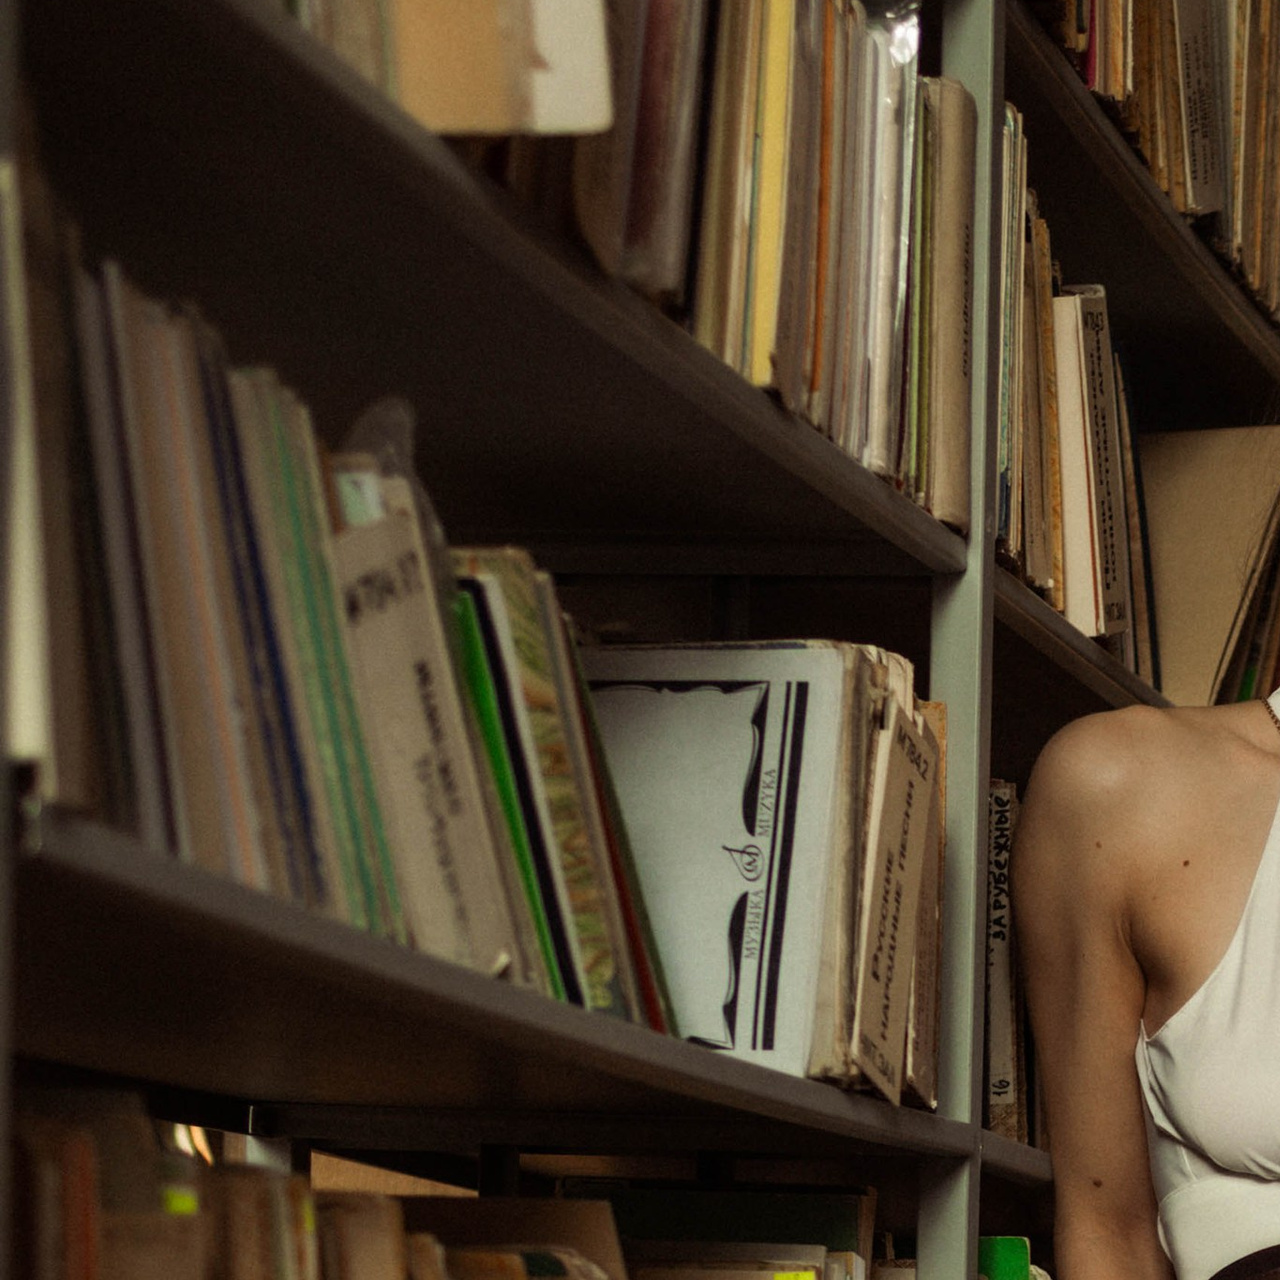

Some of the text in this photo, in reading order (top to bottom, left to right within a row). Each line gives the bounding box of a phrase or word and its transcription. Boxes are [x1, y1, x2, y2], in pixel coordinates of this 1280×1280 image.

[757, 769, 776, 837] MUZYKA
[744, 889, 764, 960] МУЗЫКА
[880, 779, 915, 1041] НАРОДНЫЕ ПЕСНИ
[992, 1079, 1010, 1098] 16
